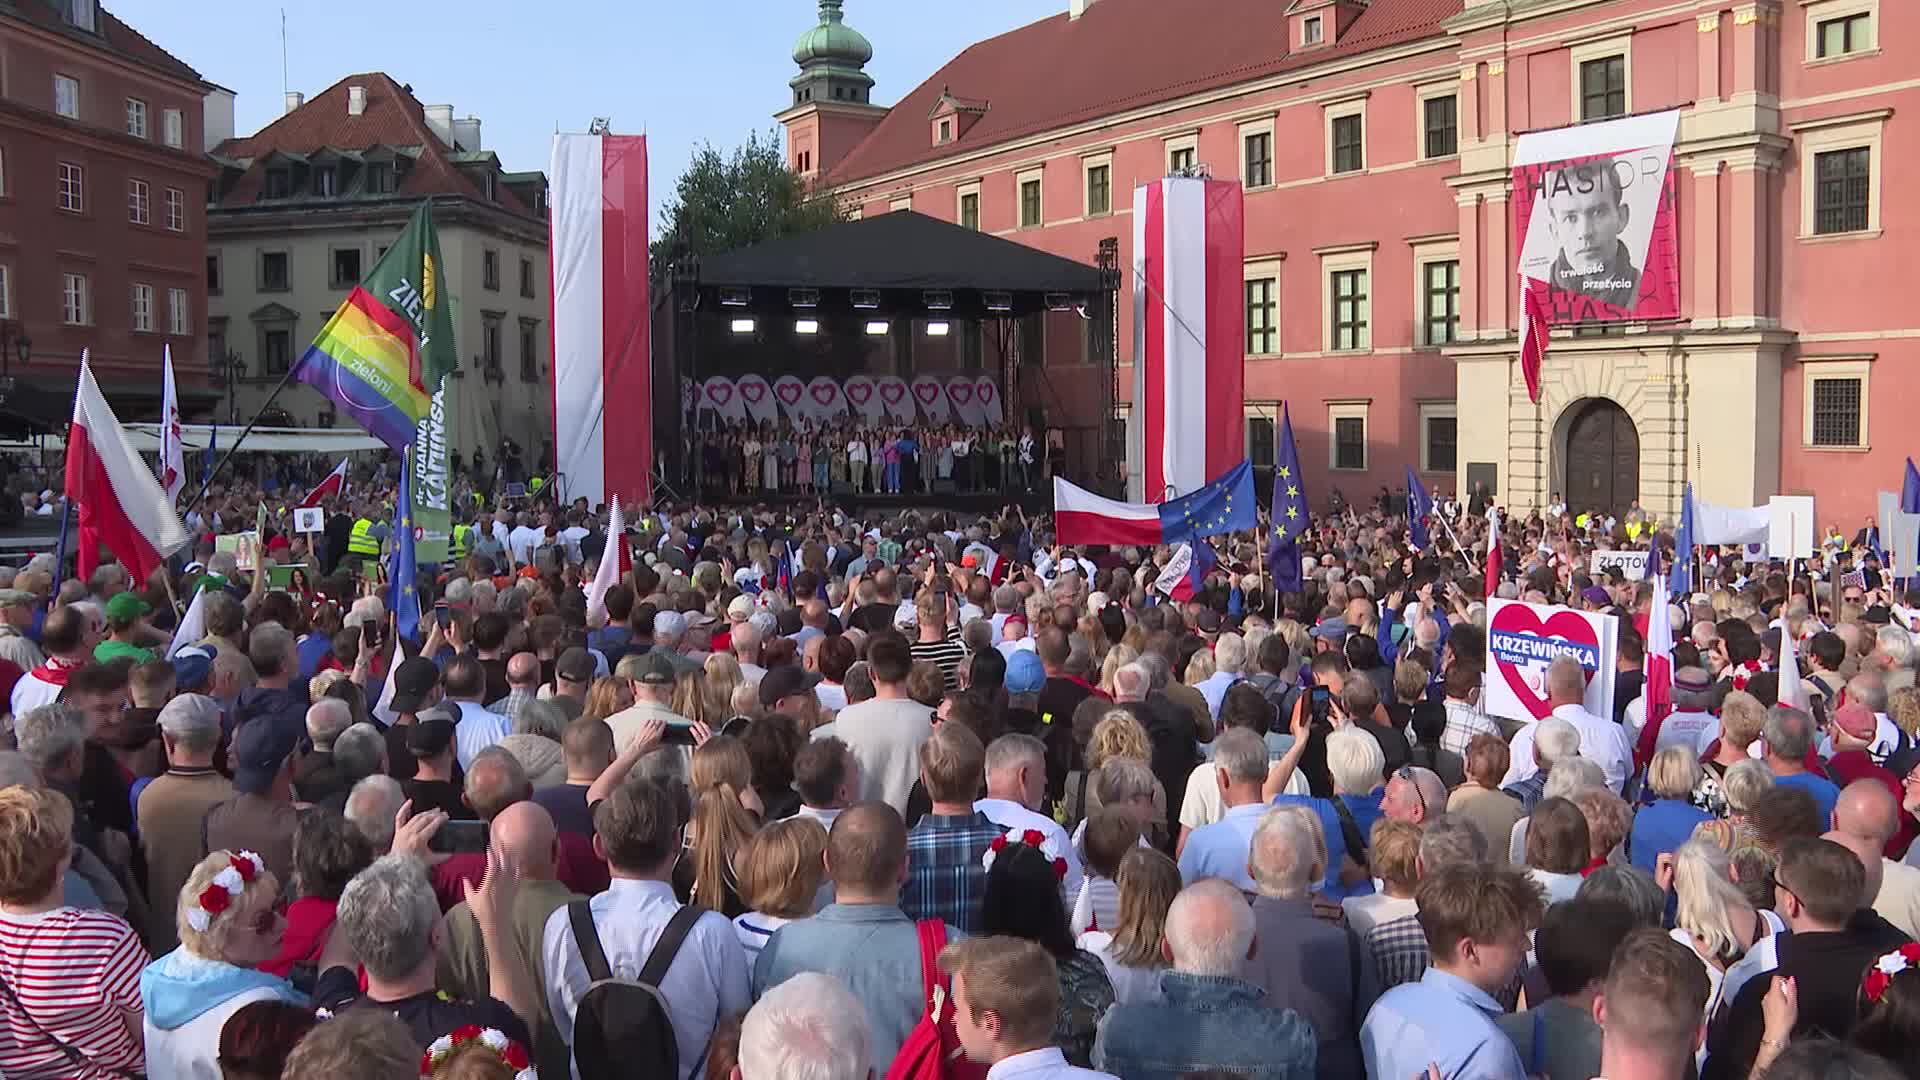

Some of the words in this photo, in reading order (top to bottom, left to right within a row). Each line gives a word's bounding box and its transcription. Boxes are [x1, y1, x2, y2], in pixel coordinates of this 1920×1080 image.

[1526, 155, 1661, 201] HASIOR
[351, 358, 392, 393] zieloni
[415, 419, 427, 486] JOANNA
[1492, 634, 1596, 667] KRZEWIŃSKA
